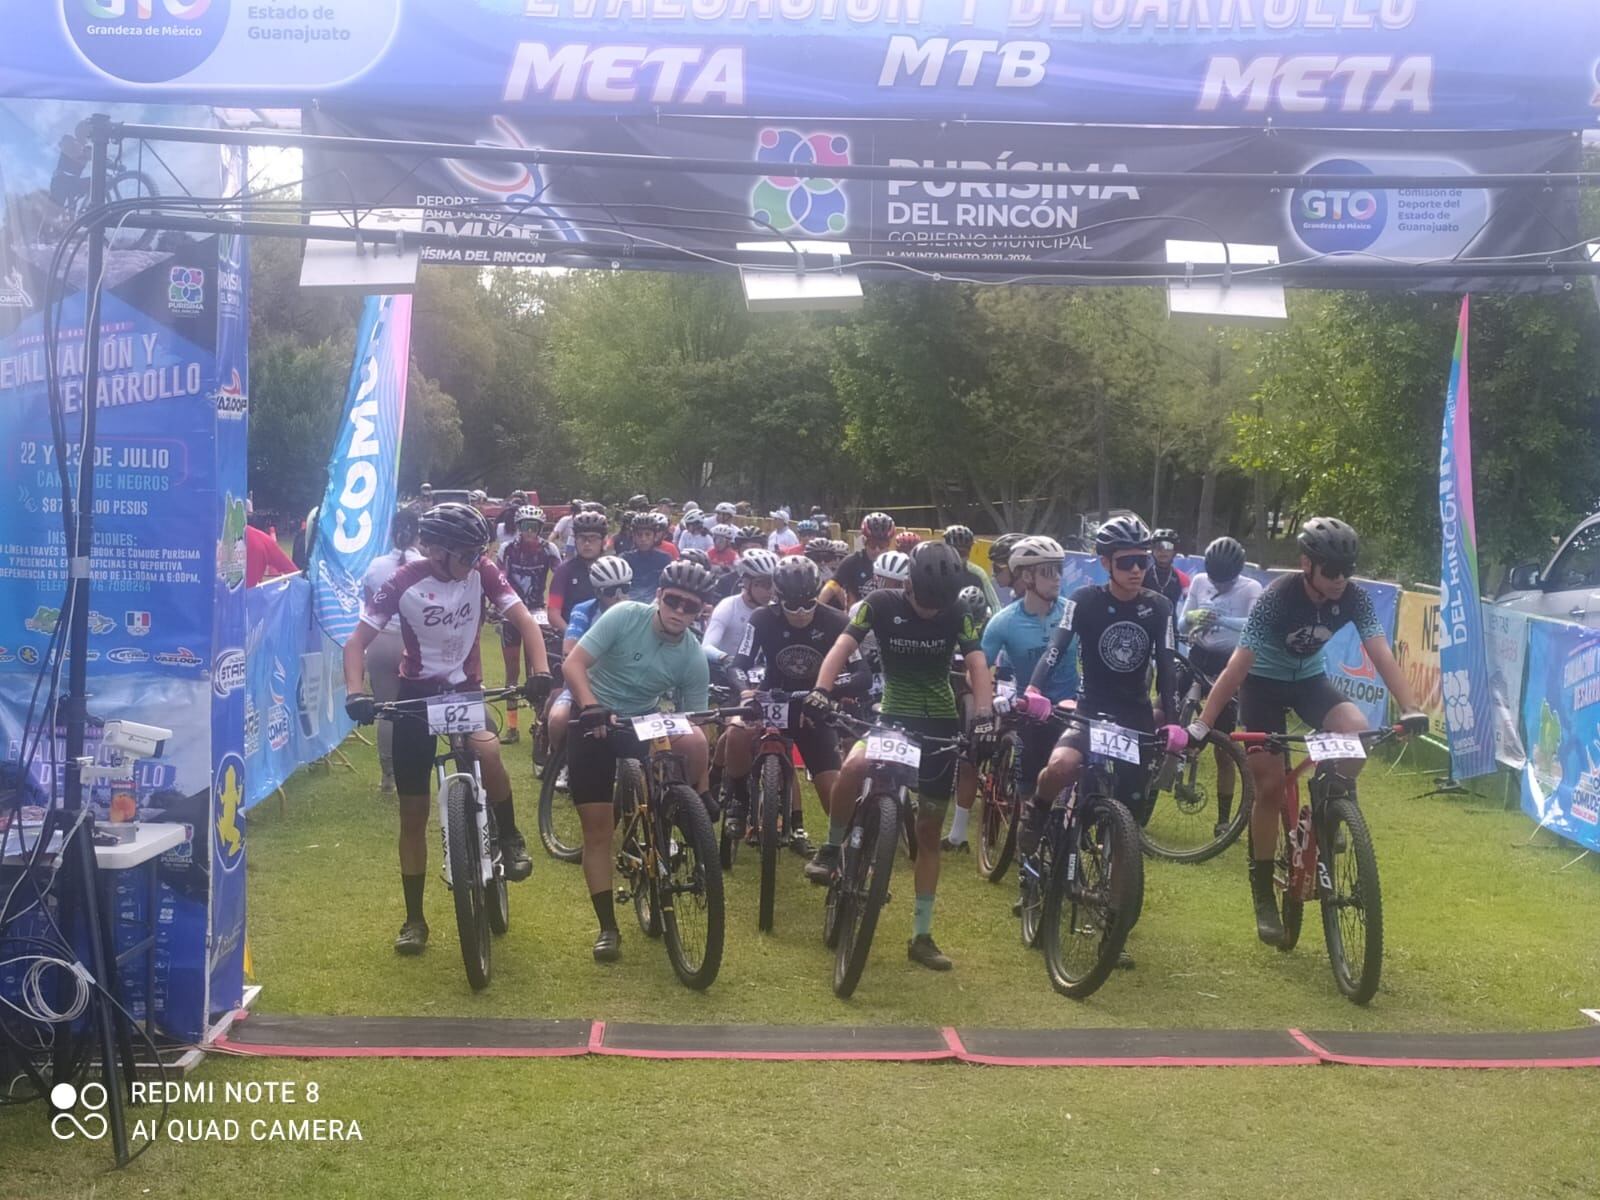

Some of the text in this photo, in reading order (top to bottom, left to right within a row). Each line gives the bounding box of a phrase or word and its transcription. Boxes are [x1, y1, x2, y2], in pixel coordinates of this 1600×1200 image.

[248, 6, 335, 20] Estado de
[87, 25, 202, 37] Grandeza de México
[248, 26, 351, 43] Guanajuato
[877, 36, 1051, 88] MTB
[504, 42, 746, 104] META
[1196, 55, 1434, 112] META
[888, 151, 1141, 200] PURÍSIMA
[888, 199, 1078, 228] DEL RINCÓN
[1302, 190, 1377, 221] GTO
[1398, 200, 1460, 210] Deporte del
[424, 209, 453, 219] ARA
[1398, 211, 1451, 220] Estado de
[1303, 222, 1336, 230] Grandeza
[1398, 223, 1460, 233] Guanajuato
[888, 231, 1094, 250] GOBIERNO MUNICIPAL
[420, 247, 462, 260] ÍSIMA
[464, 250, 491, 262] DEL
[20, 441, 36, 465] 22
[42, 444, 54, 465] Y
[93, 446, 112, 467] DE
[118, 448, 169, 470] JULIO
[95, 472, 113, 490] DE
[117, 473, 169, 492] NEGROS
[113, 500, 148, 516] PESOS
[1450, 590, 1468, 645] DEL
[445, 704, 471, 723] 62
[650, 719, 676, 732] 99
[882, 739, 909, 756] 96
[1100, 731, 1133, 752] 117
[1317, 739, 1357, 754] 116
